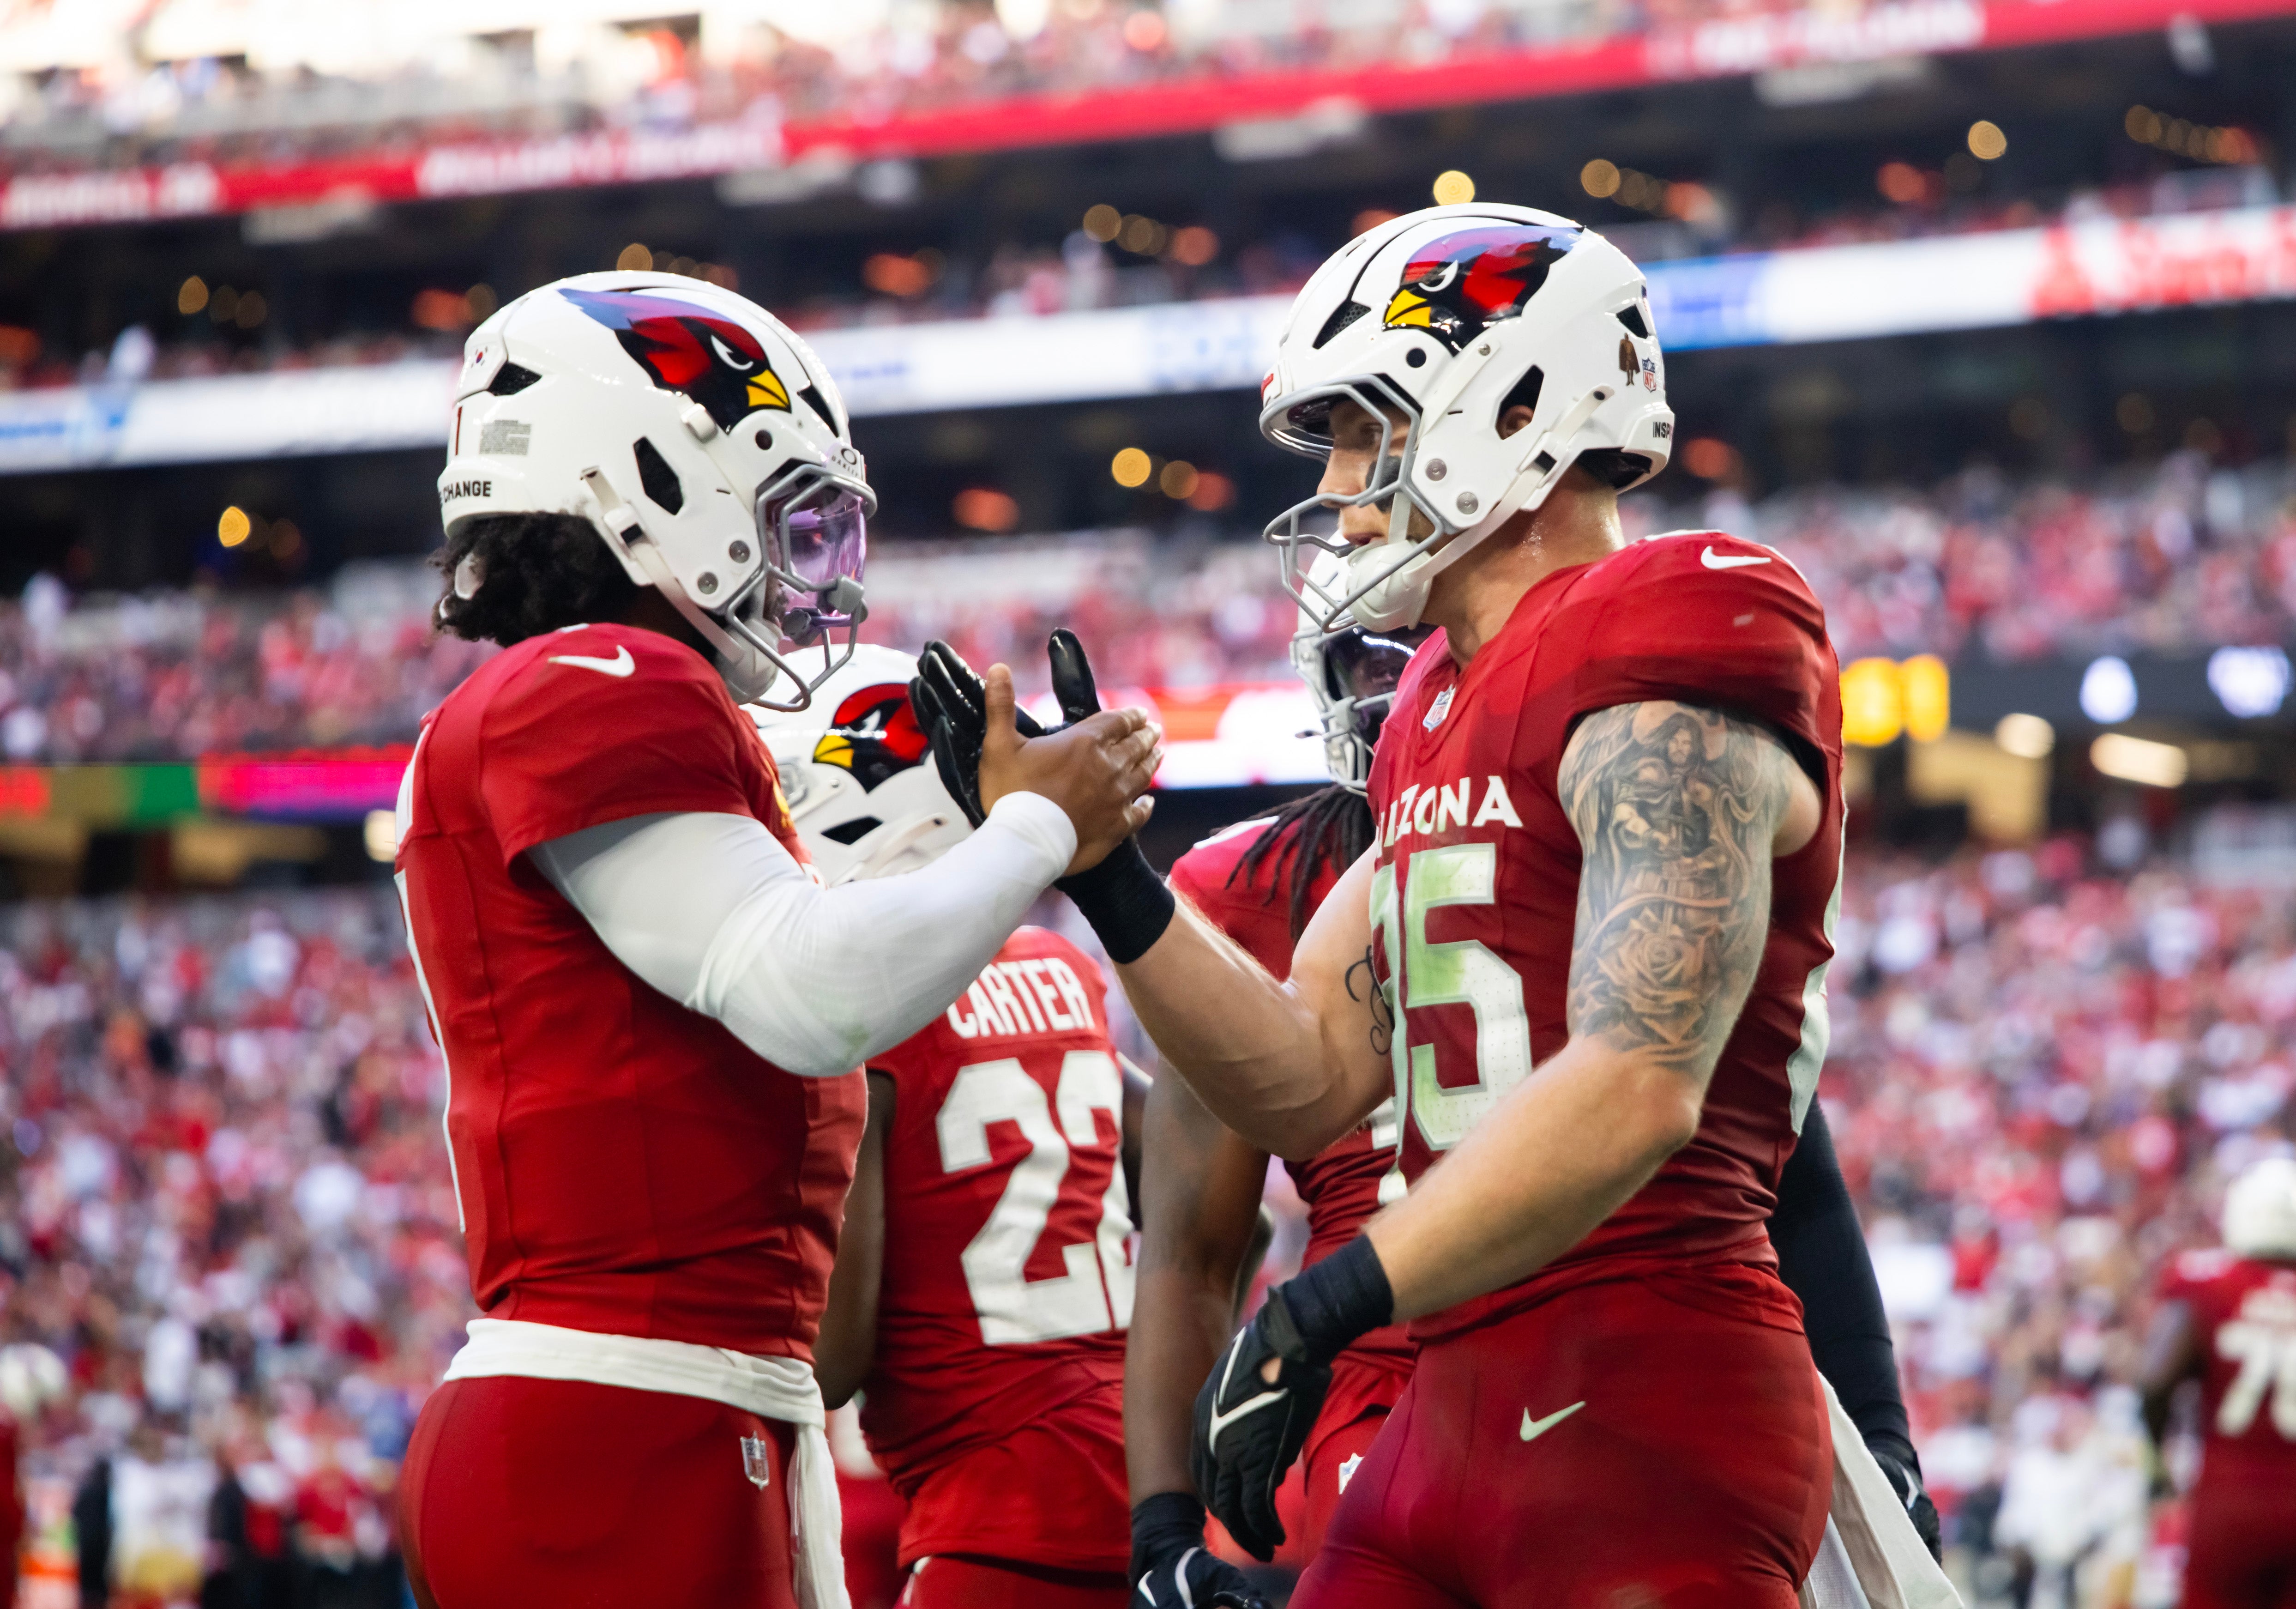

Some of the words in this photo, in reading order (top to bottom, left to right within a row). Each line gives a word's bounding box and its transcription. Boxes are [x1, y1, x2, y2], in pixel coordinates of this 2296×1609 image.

[443, 480, 492, 503] CHANGE
[831, 455, 858, 478] OAKLEY
[946, 957, 1096, 1039] CARTER
[935, 1049, 1138, 1346] 22
